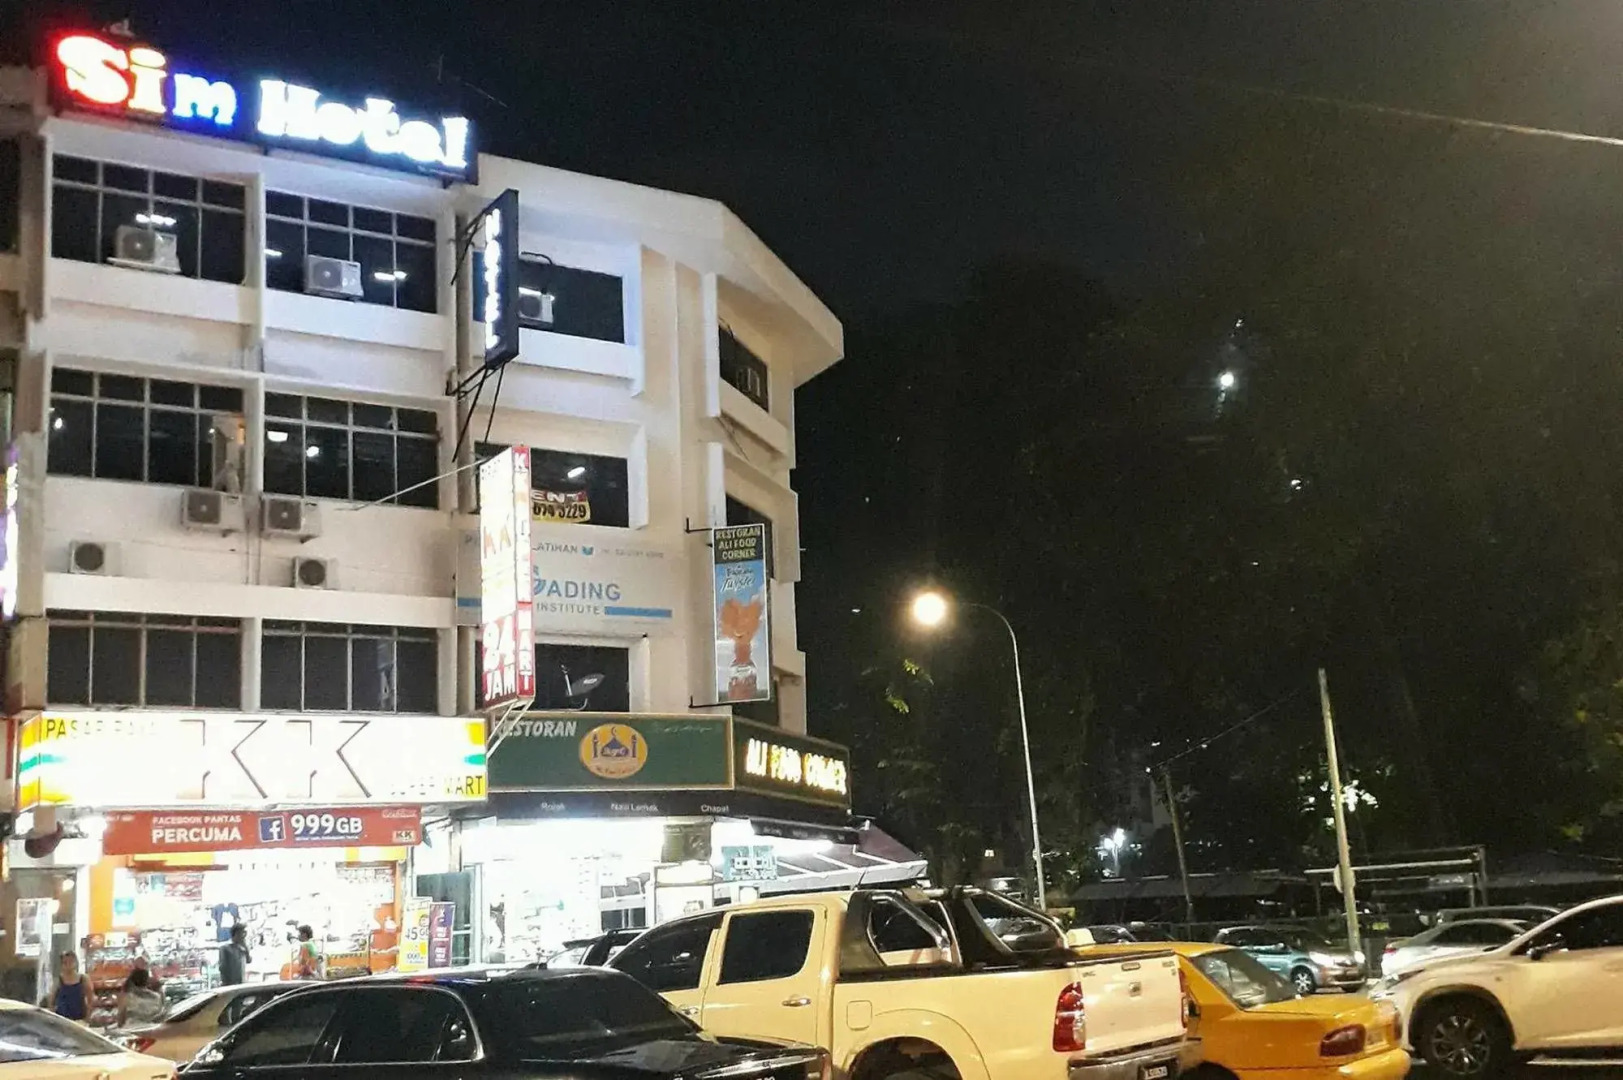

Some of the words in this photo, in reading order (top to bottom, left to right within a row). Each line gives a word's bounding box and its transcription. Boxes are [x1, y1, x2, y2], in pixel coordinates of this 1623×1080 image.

[57, 36, 237, 124] Sim
[257, 80, 469, 168] Hotel
[536, 602, 600, 615] INSTITUTE
[484, 664, 516, 701] JAM
[497, 720, 577, 739] STORAN
[152, 815, 202, 825] FACEBOOK
[204, 814, 242, 824] PANTAS
[290, 813, 363, 835] 999GB
[151, 826, 242, 844] PERCUMA
